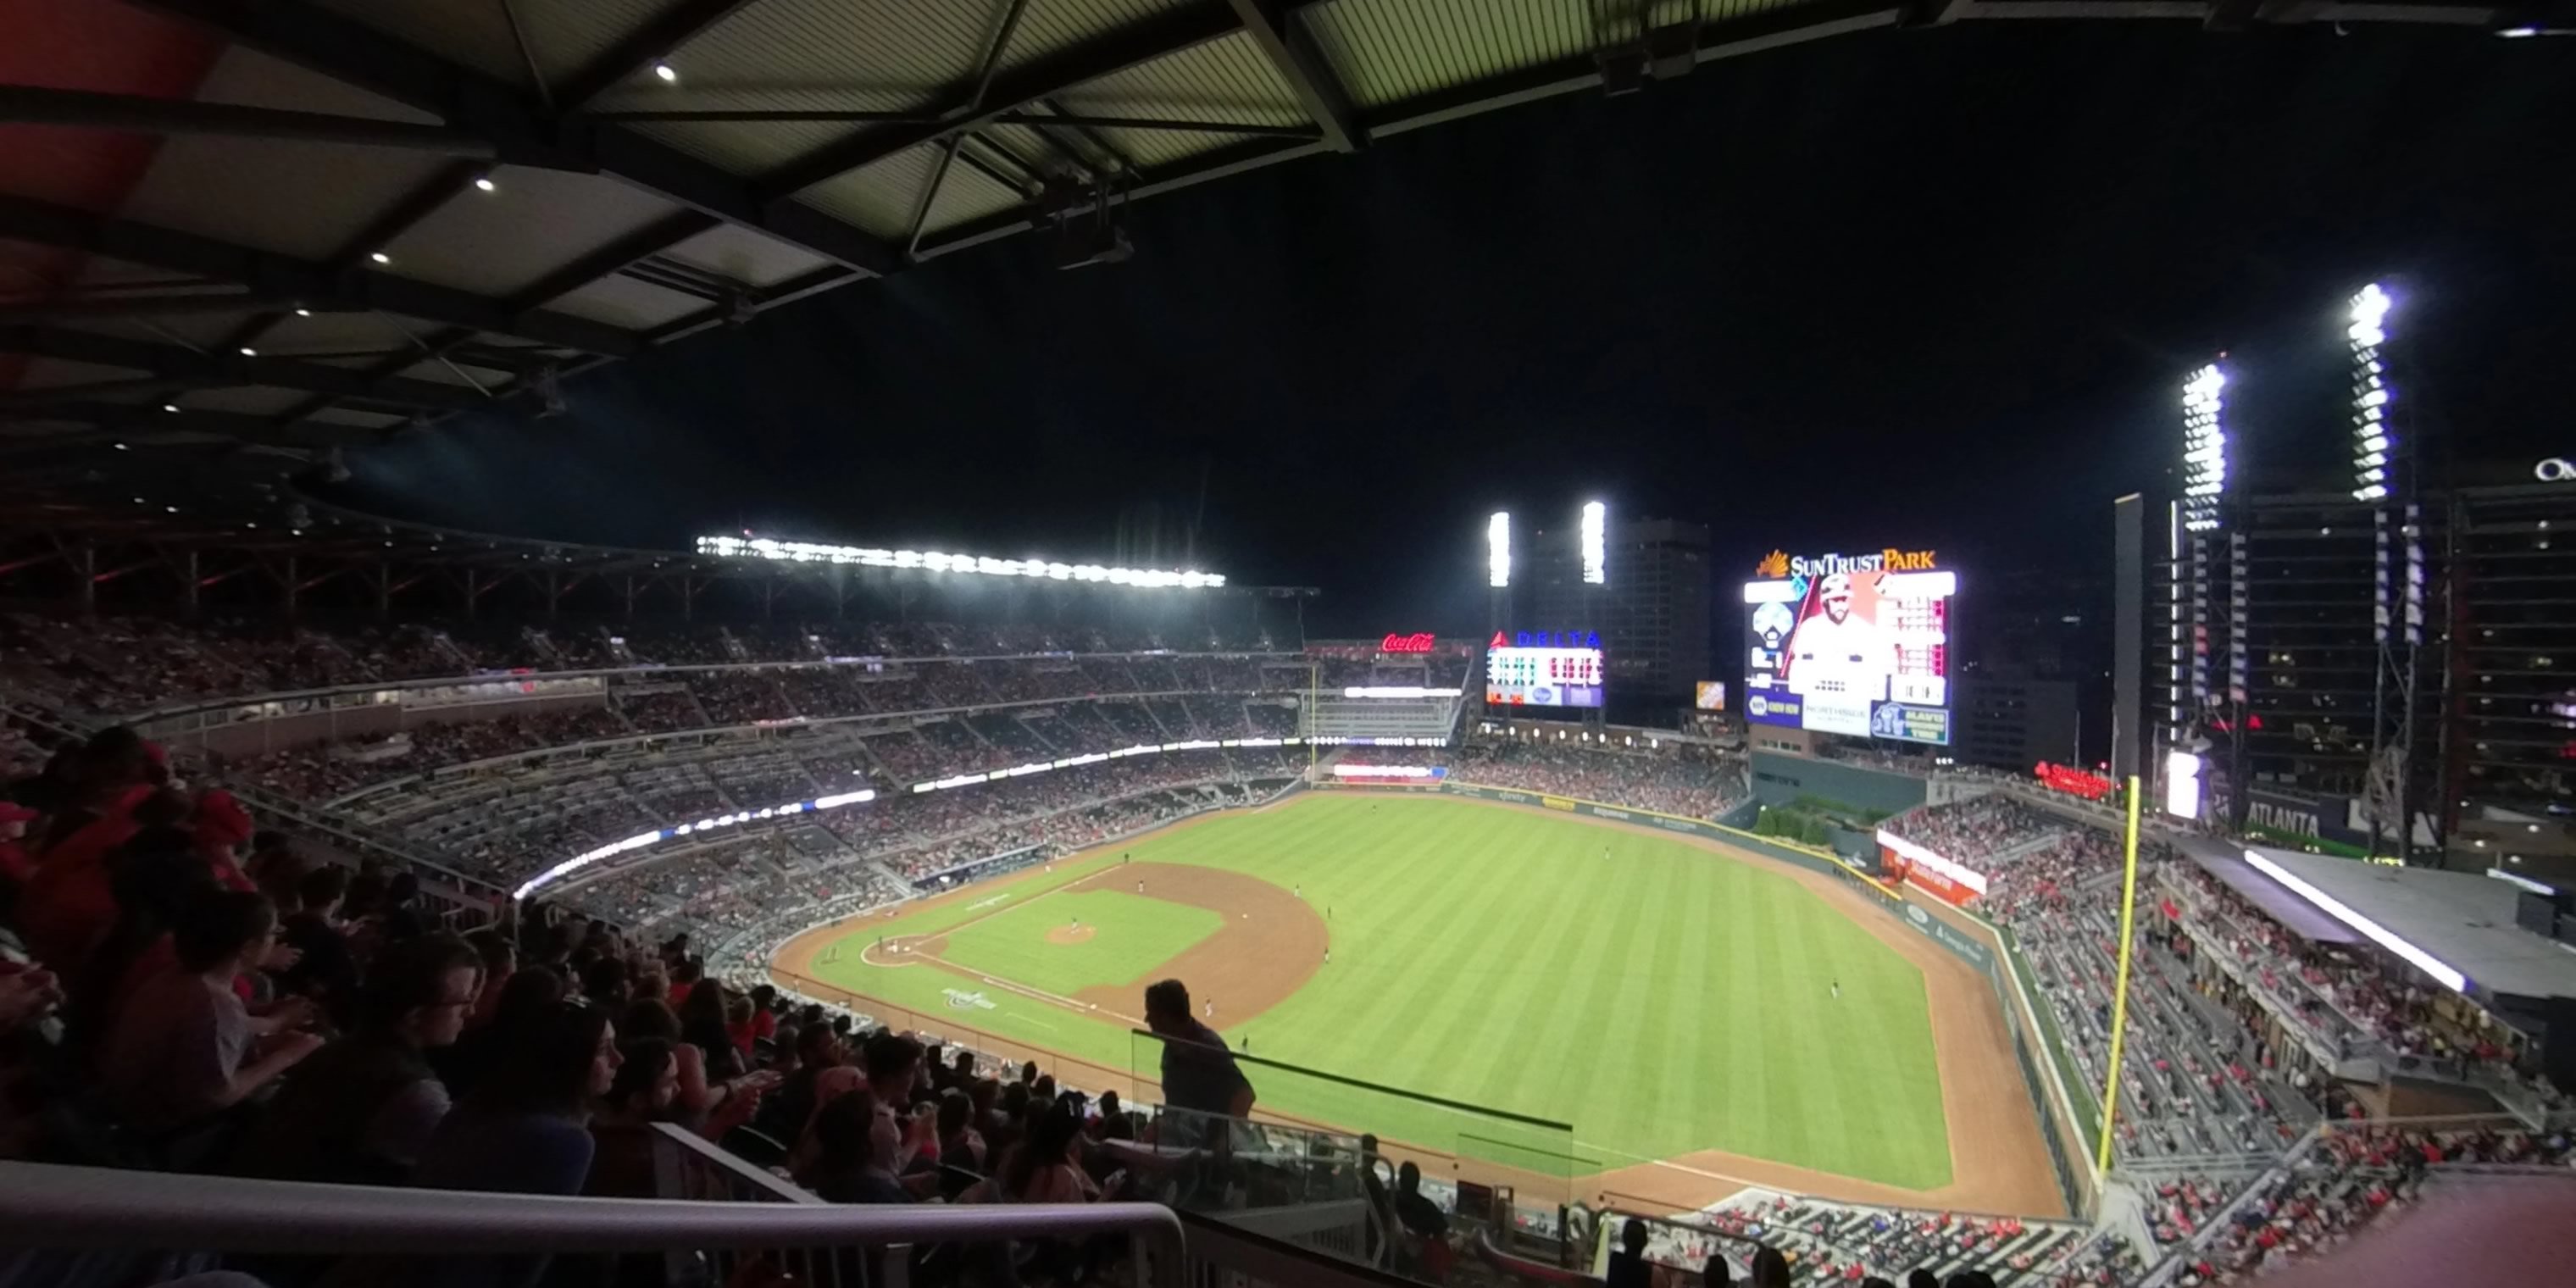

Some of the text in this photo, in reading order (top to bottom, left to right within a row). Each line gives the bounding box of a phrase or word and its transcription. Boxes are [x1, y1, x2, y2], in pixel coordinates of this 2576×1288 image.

[1882, 548, 1935, 570] PARK
[1517, 630, 1602, 647] DELTA
[2247, 802, 2319, 839] ATLANTA
